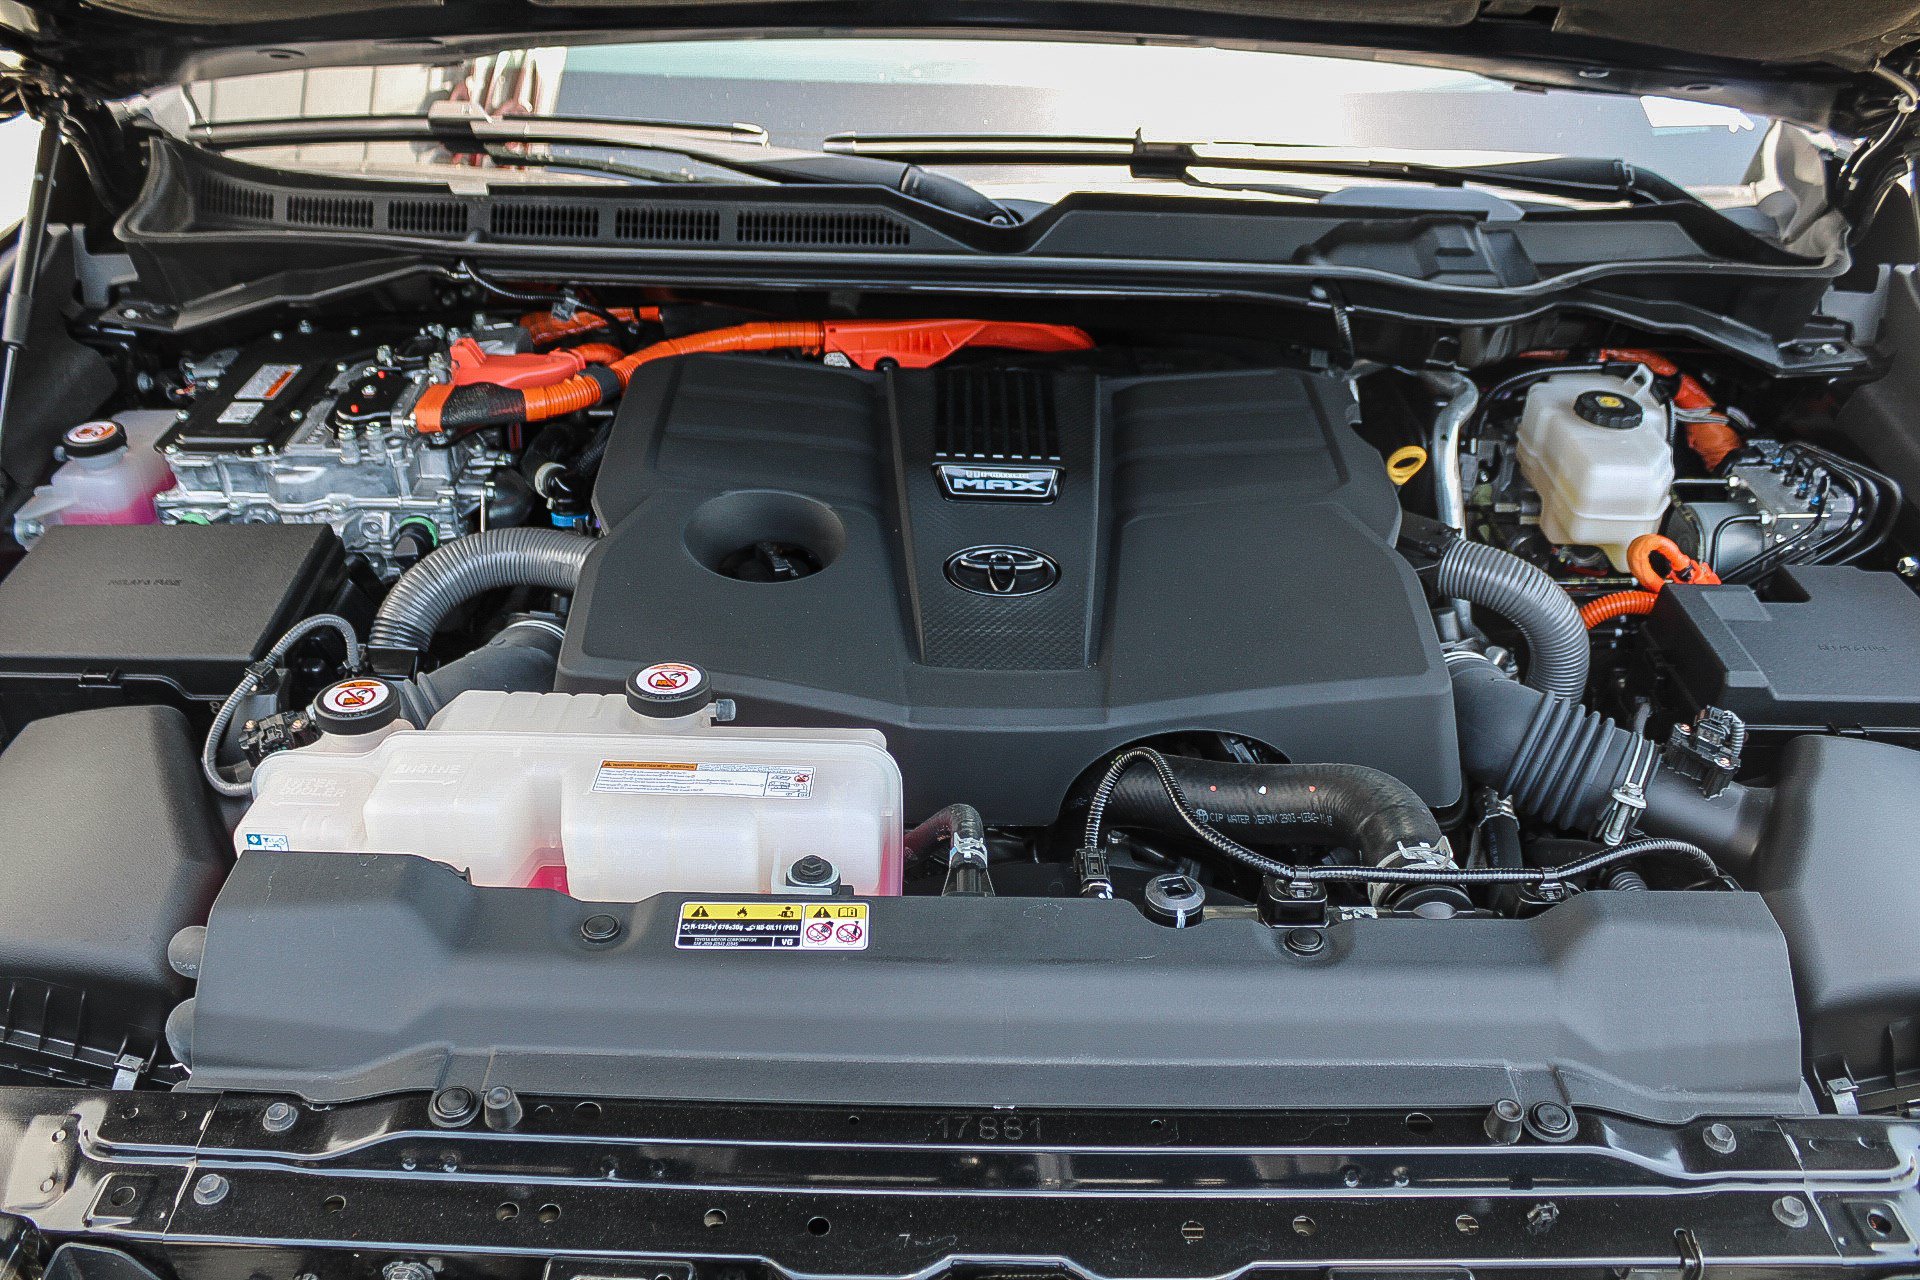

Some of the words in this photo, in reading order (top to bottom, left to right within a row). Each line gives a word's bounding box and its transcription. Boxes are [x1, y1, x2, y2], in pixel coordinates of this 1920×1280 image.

[953, 478, 1046, 492] MAX
[781, 938, 794, 946] VG
[936, 1116, 1042, 1140] 17881
